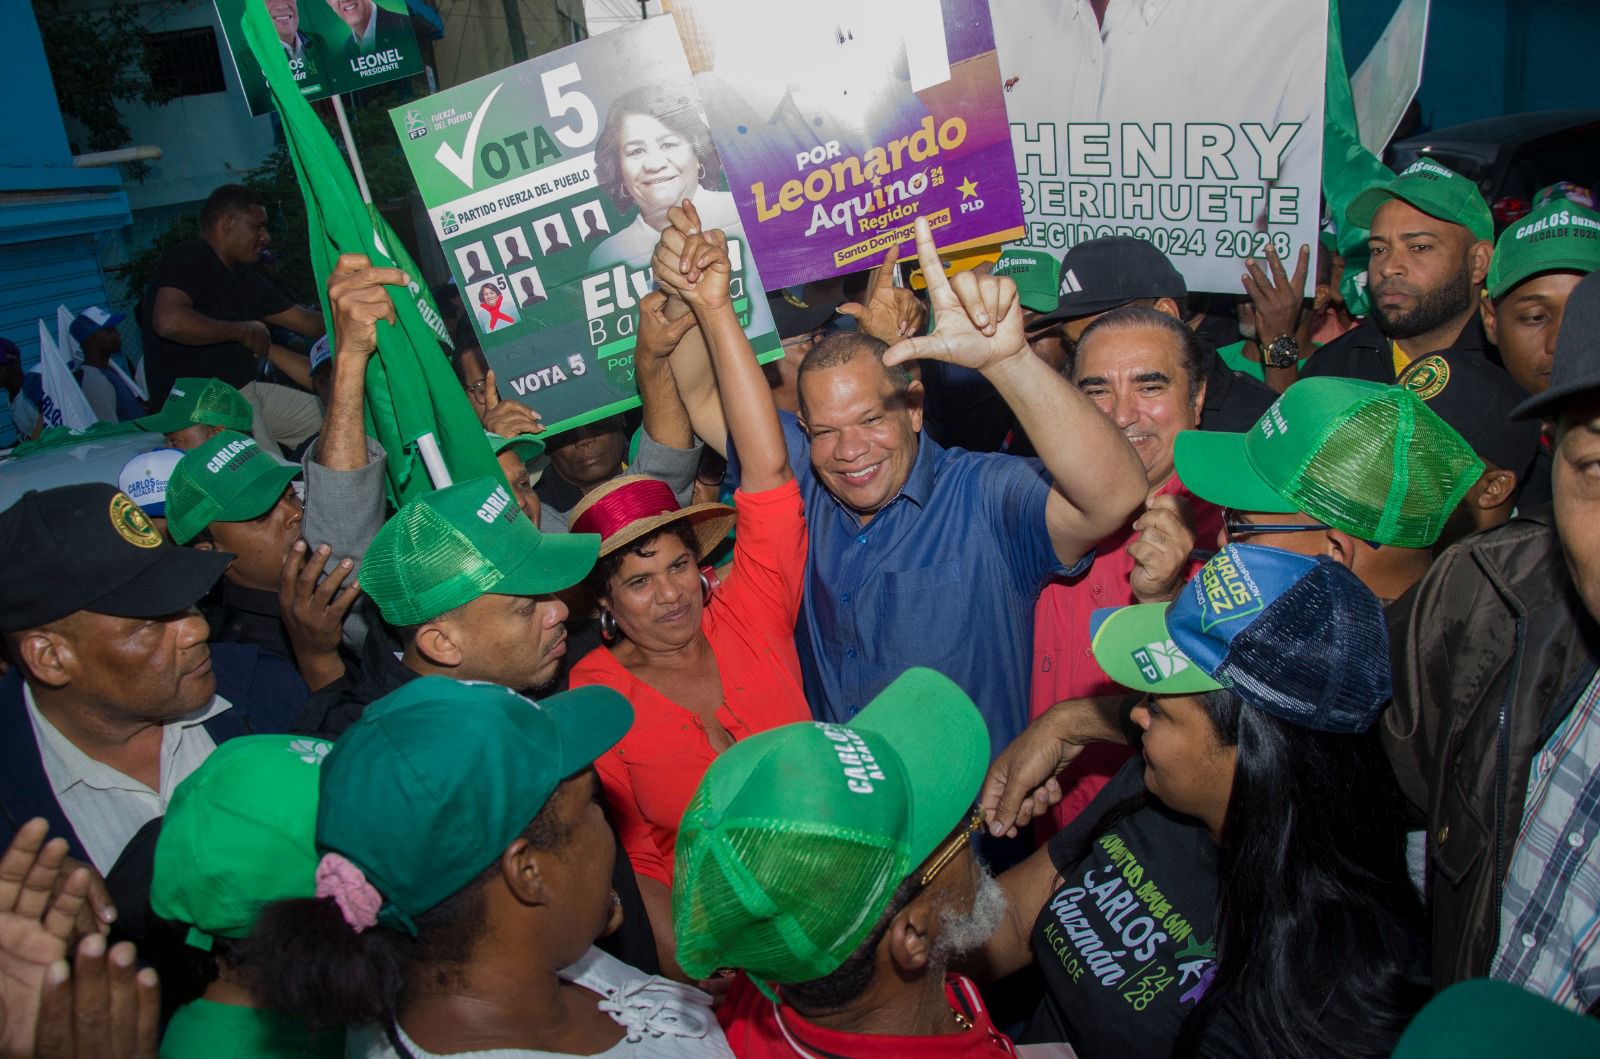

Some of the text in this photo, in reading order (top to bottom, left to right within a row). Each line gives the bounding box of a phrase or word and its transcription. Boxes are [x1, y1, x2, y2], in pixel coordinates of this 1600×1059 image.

[350, 48, 403, 72] LEONEL
[360, 62, 399, 78] PRESIDENTE
[431, 108, 456, 122] FUERZA
[540, 62, 599, 148] 5
[410, 128, 427, 140] FP
[434, 120, 448, 132] DEL
[795, 140, 841, 171] POR
[1010, 122, 1302, 181] HENRY
[751, 116, 967, 222] Leonardo
[930, 165, 943, 178] 24
[932, 174, 944, 188] 28
[458, 169, 590, 224] PARTIDO FUERZA DEL PUEBLO
[804, 172, 928, 237] Aquino
[960, 200, 984, 214] PLD
[1018, 181, 1299, 224] BERIHUETE
[858, 202, 920, 232] Regidor
[1516, 210, 1570, 240] CARLOS
[838, 214, 948, 262] Santo Domingo orte
[1215, 230, 1290, 260] 2028
[496, 276, 506, 291] 5
[510, 353, 586, 396] VOTA 5
[608, 354, 634, 370] Por
[206, 440, 246, 474] CARLOS
[128, 478, 156, 494] CARLOS
[1215, 547, 1252, 606] ARLOS
[1134, 652, 1158, 680] FP
[1050, 887, 1126, 986] Guzmán
[1044, 922, 1084, 984] ALCALDE
[1142, 966, 1175, 994] 24
[1124, 982, 1155, 1010] 28
